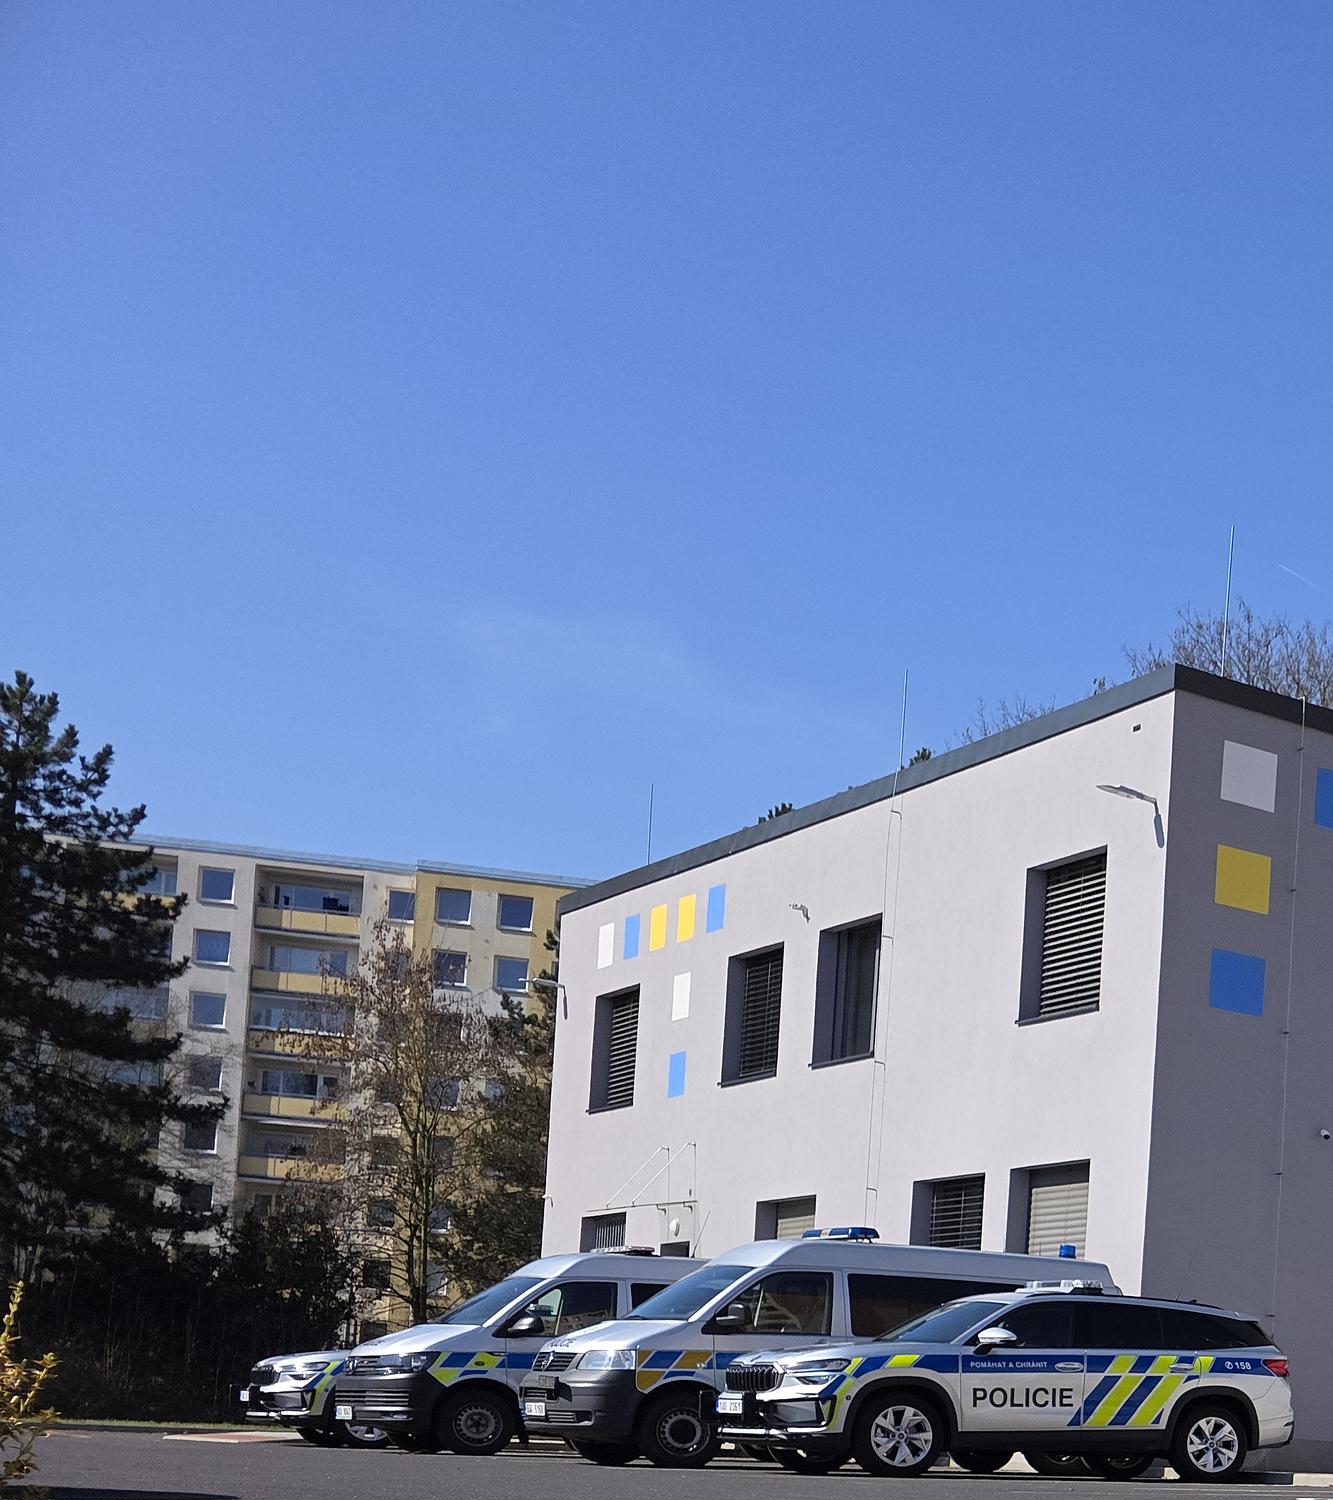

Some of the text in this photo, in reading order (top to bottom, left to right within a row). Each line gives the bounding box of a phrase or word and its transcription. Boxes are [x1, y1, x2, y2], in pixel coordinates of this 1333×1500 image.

[970, 1360, 1006, 1368] POMÁHAT
[1015, 1360, 1048, 1368] CHRÁNIT
[1234, 1361, 1251, 1370] 158
[972, 1387, 1074, 1408] POLICIE
